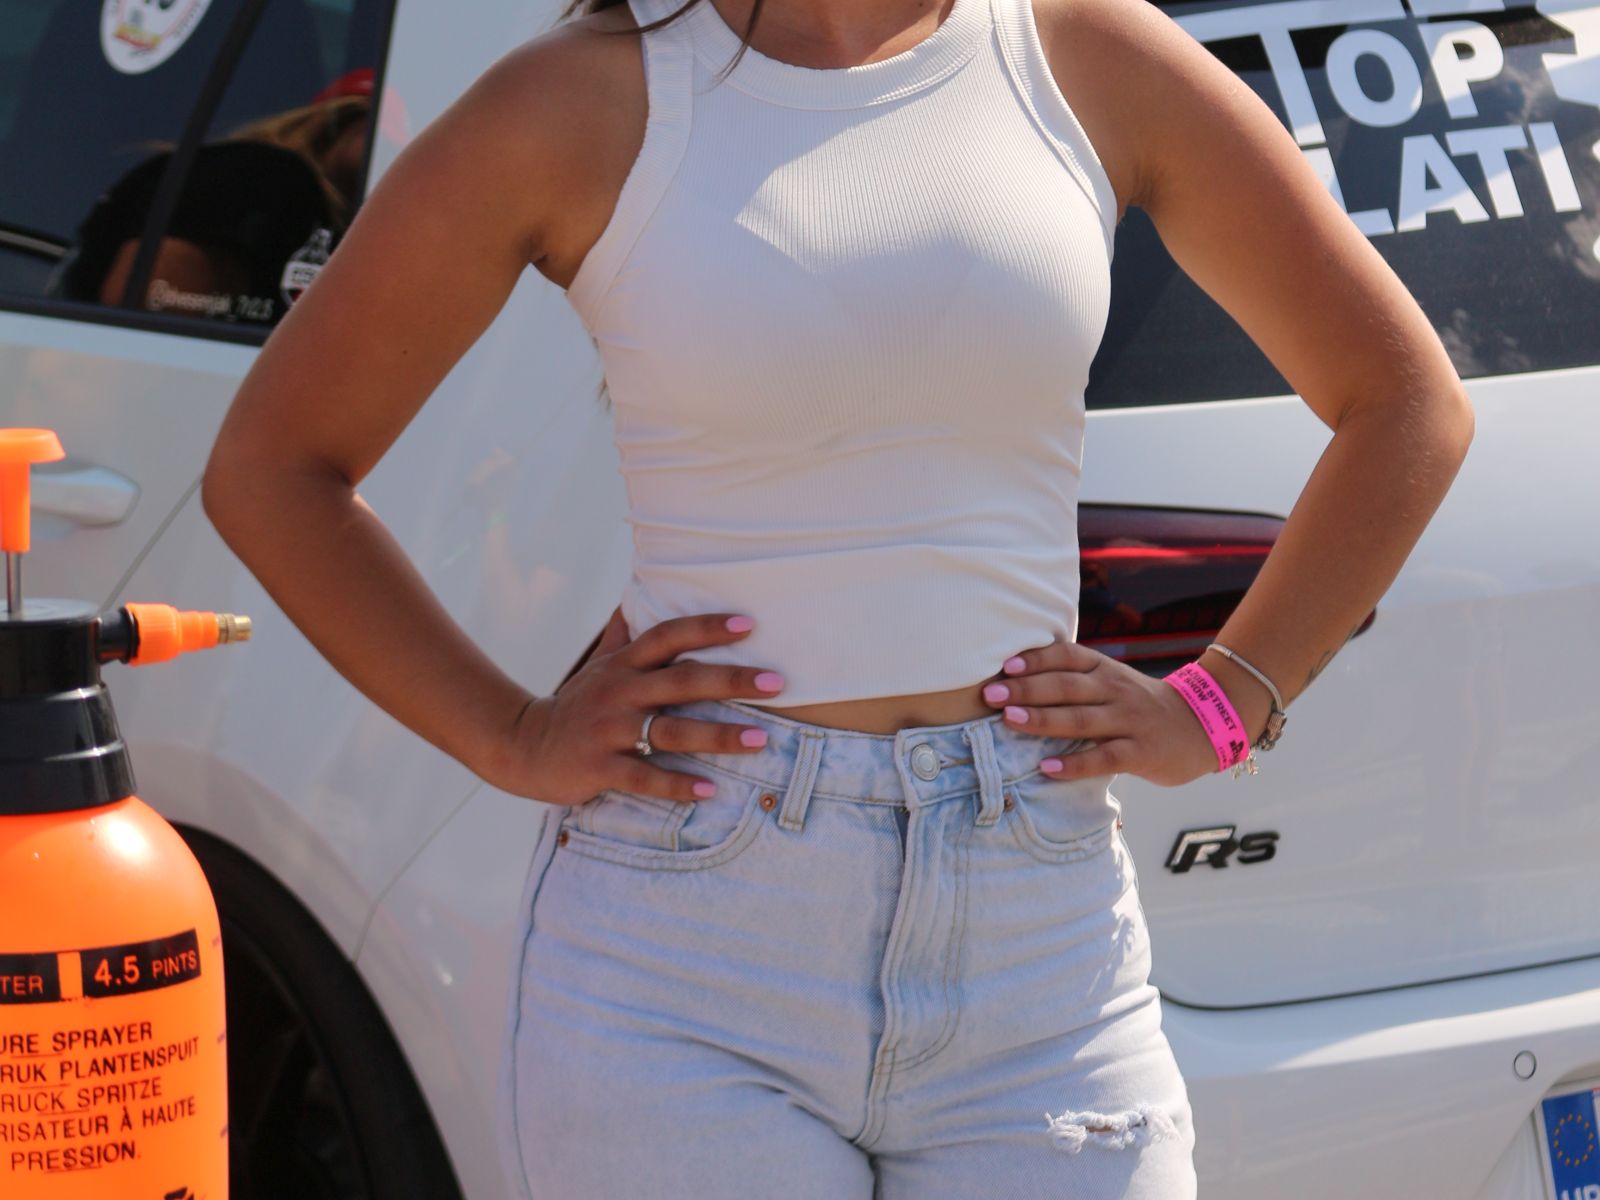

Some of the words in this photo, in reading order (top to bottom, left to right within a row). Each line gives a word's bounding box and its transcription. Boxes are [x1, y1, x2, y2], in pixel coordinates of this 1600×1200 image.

[1302, 121, 1600, 237] LATI
[1185, 678, 1209, 702] SHOW
[1207, 689, 1237, 731] STREET
[1164, 824, 1280, 874] RS
[94, 954, 140, 987] 4.5
[151, 949, 198, 979] PINTS
[52, 1021, 153, 1052] SPRAYER
[59, 1036, 200, 1081] PLANTENSPUIT
[0, 1090, 66, 1113] RUCK
[77, 1076, 162, 1108] SPRITZE
[120, 1105, 133, 1132] À
[142, 1096, 196, 1128] HAUTE
